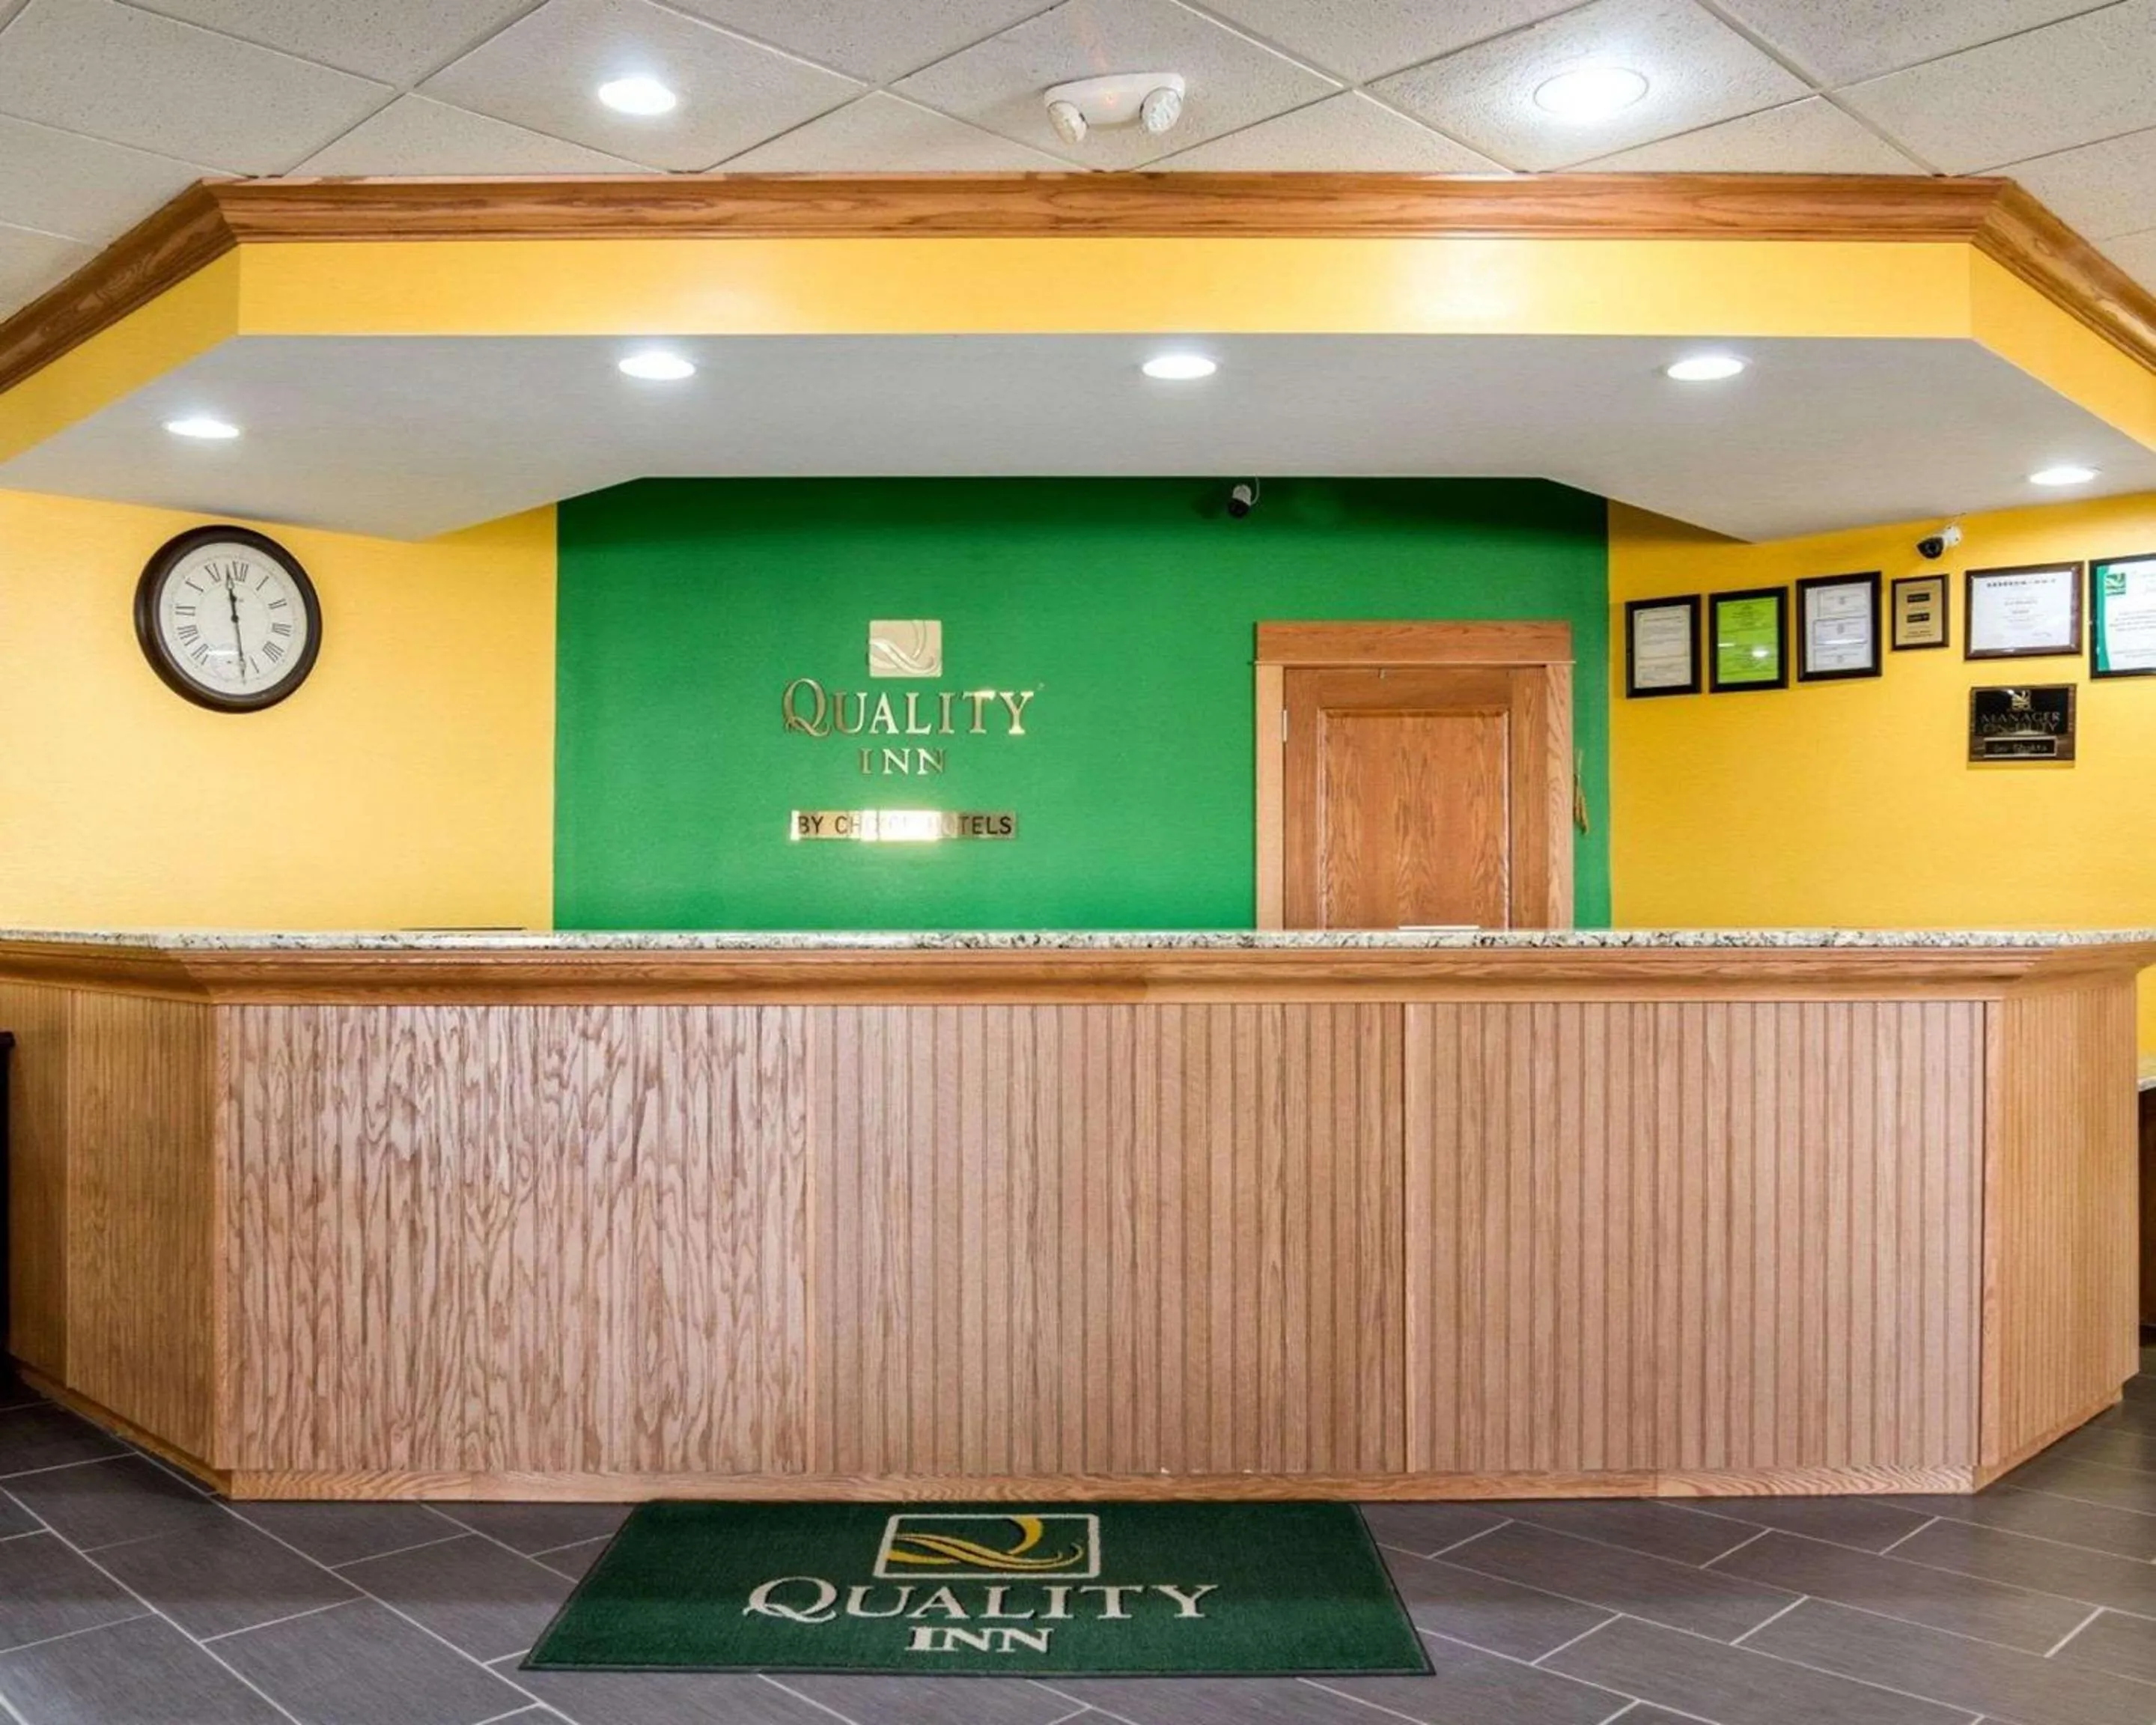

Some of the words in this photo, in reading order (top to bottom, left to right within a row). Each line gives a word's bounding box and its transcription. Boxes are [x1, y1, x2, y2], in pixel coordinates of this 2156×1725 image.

[782, 678, 1035, 737] QUALITY
[1979, 711, 2061, 723] MANAGER
[860, 748, 944, 775] INN
[798, 815, 823, 835] BY
[743, 1575, 1219, 1623] QUALITY
[905, 1625, 1054, 1653] INN
